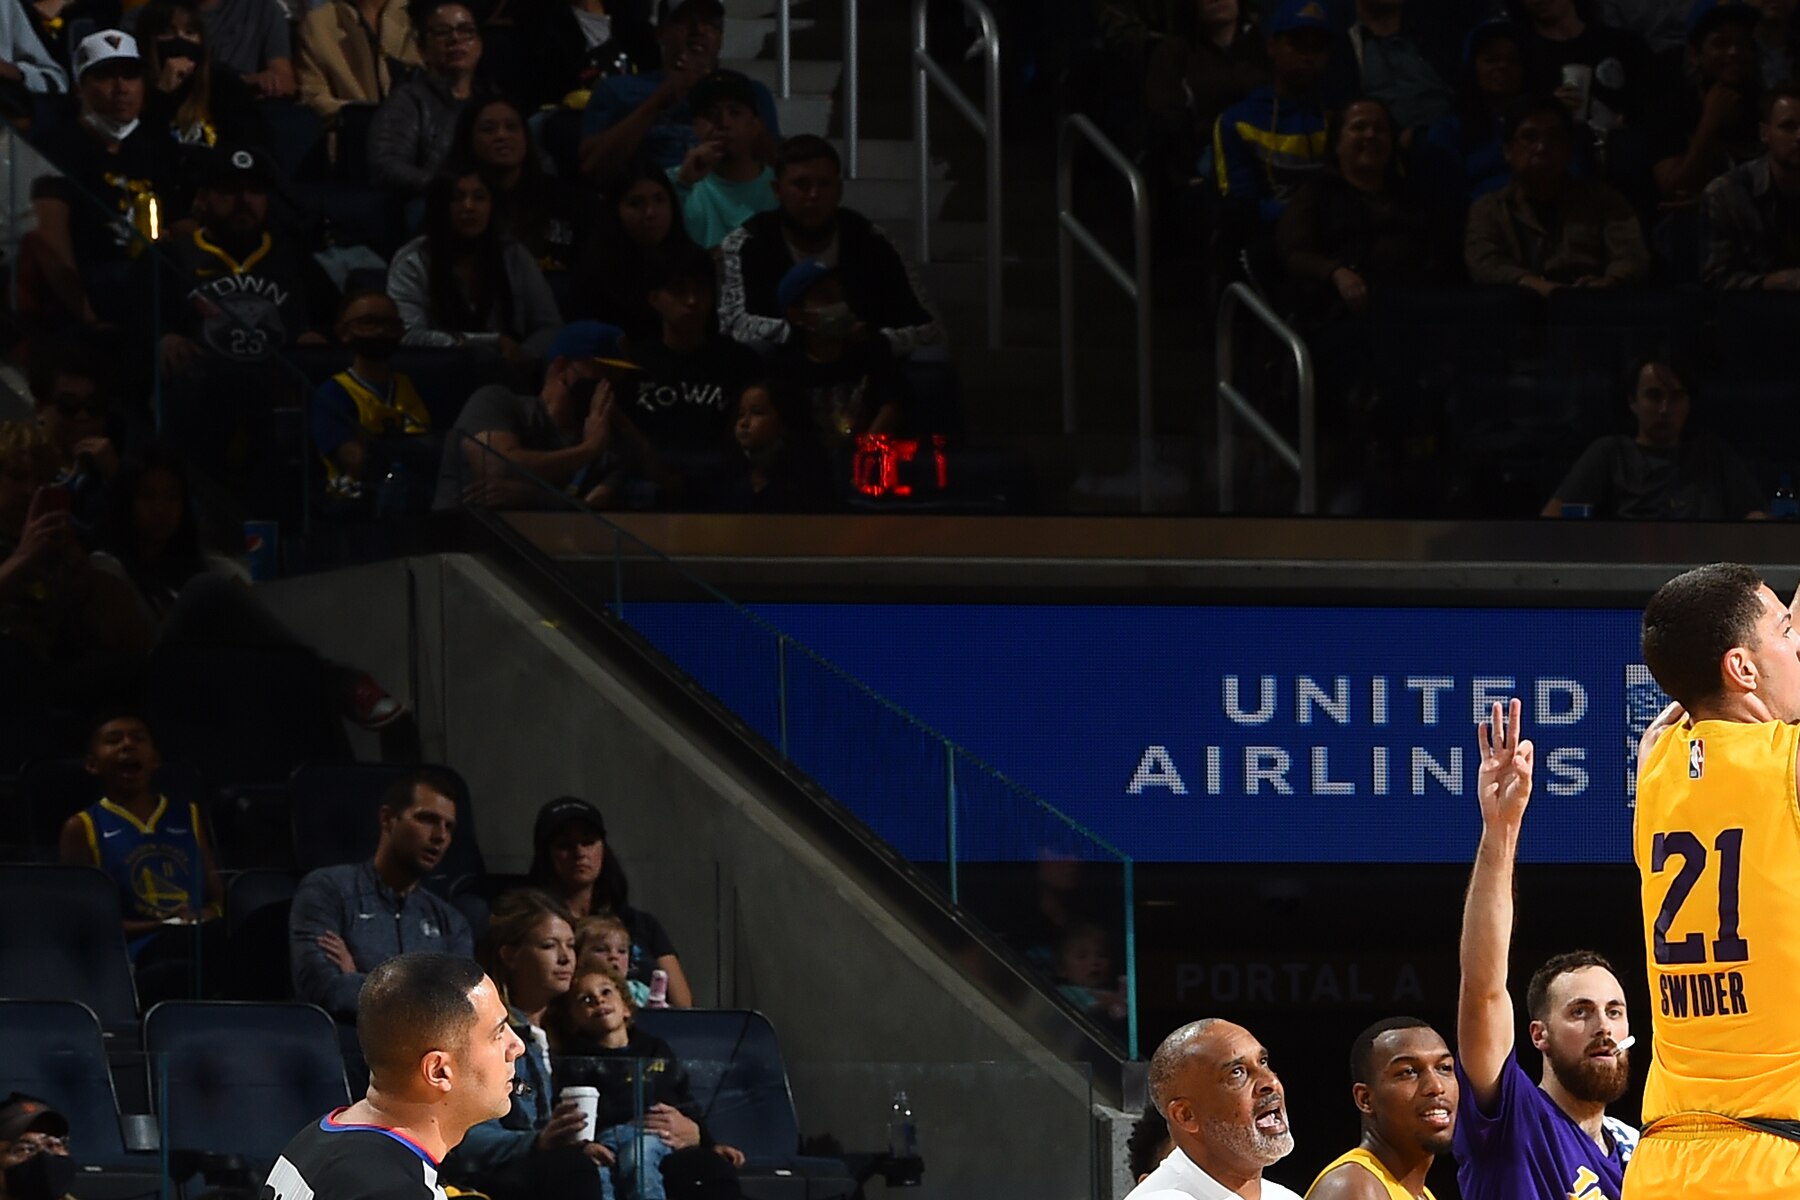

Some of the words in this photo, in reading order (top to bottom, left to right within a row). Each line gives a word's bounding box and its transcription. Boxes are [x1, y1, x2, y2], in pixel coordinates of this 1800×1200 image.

[1222, 675, 1589, 725] UNITED
[1126, 744, 1590, 796] AIRLINS
[1651, 828, 1749, 965] 21
[1174, 962, 1375, 1001] PORTAL
[1392, 962, 1425, 1001] A
[1659, 971, 1749, 1018] SWIDER
